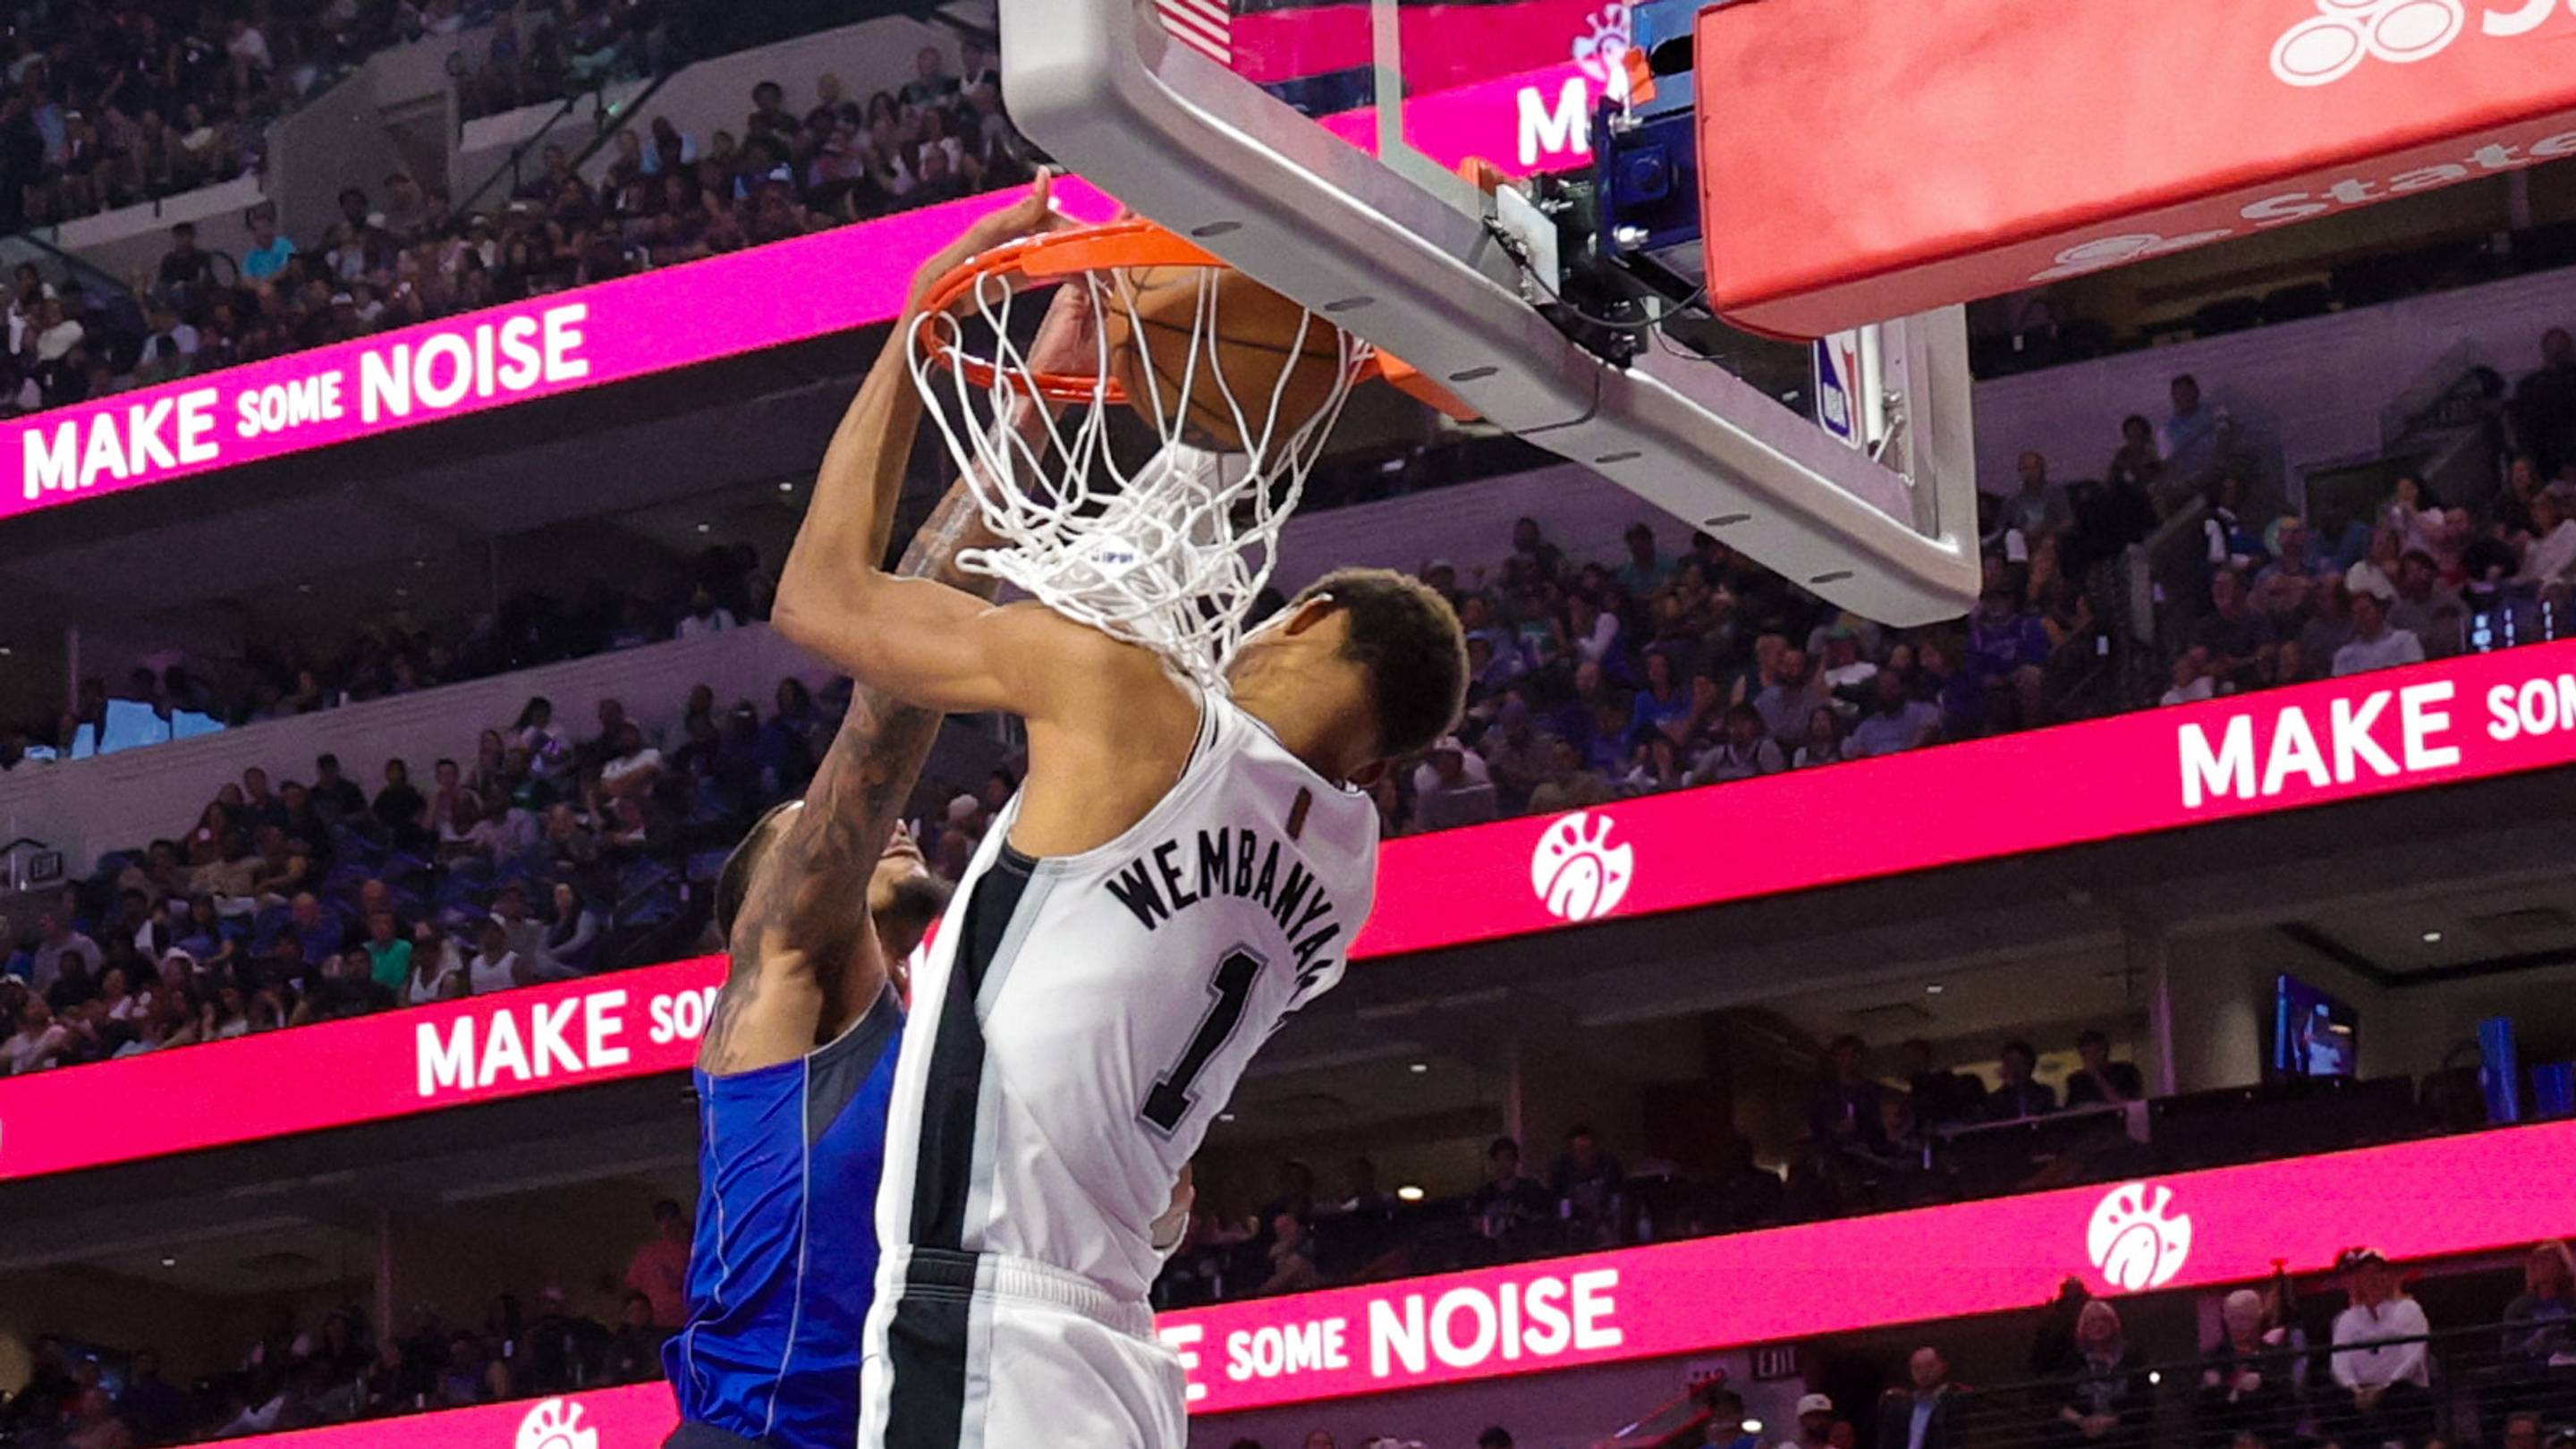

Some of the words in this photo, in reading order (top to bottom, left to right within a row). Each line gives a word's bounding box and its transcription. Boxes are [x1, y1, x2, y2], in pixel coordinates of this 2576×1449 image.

[23, 388, 219, 499] MAKE
[237, 370, 343, 437] SOME
[360, 303, 589, 423] NOISE
[2179, 681, 2460, 808] MAKE
[417, 989, 629, 1096] MAKE
[1135, 941, 1268, 1142] 1
[1226, 1318, 1349, 1381] SOME
[1369, 1268, 1623, 1377] NOISE
